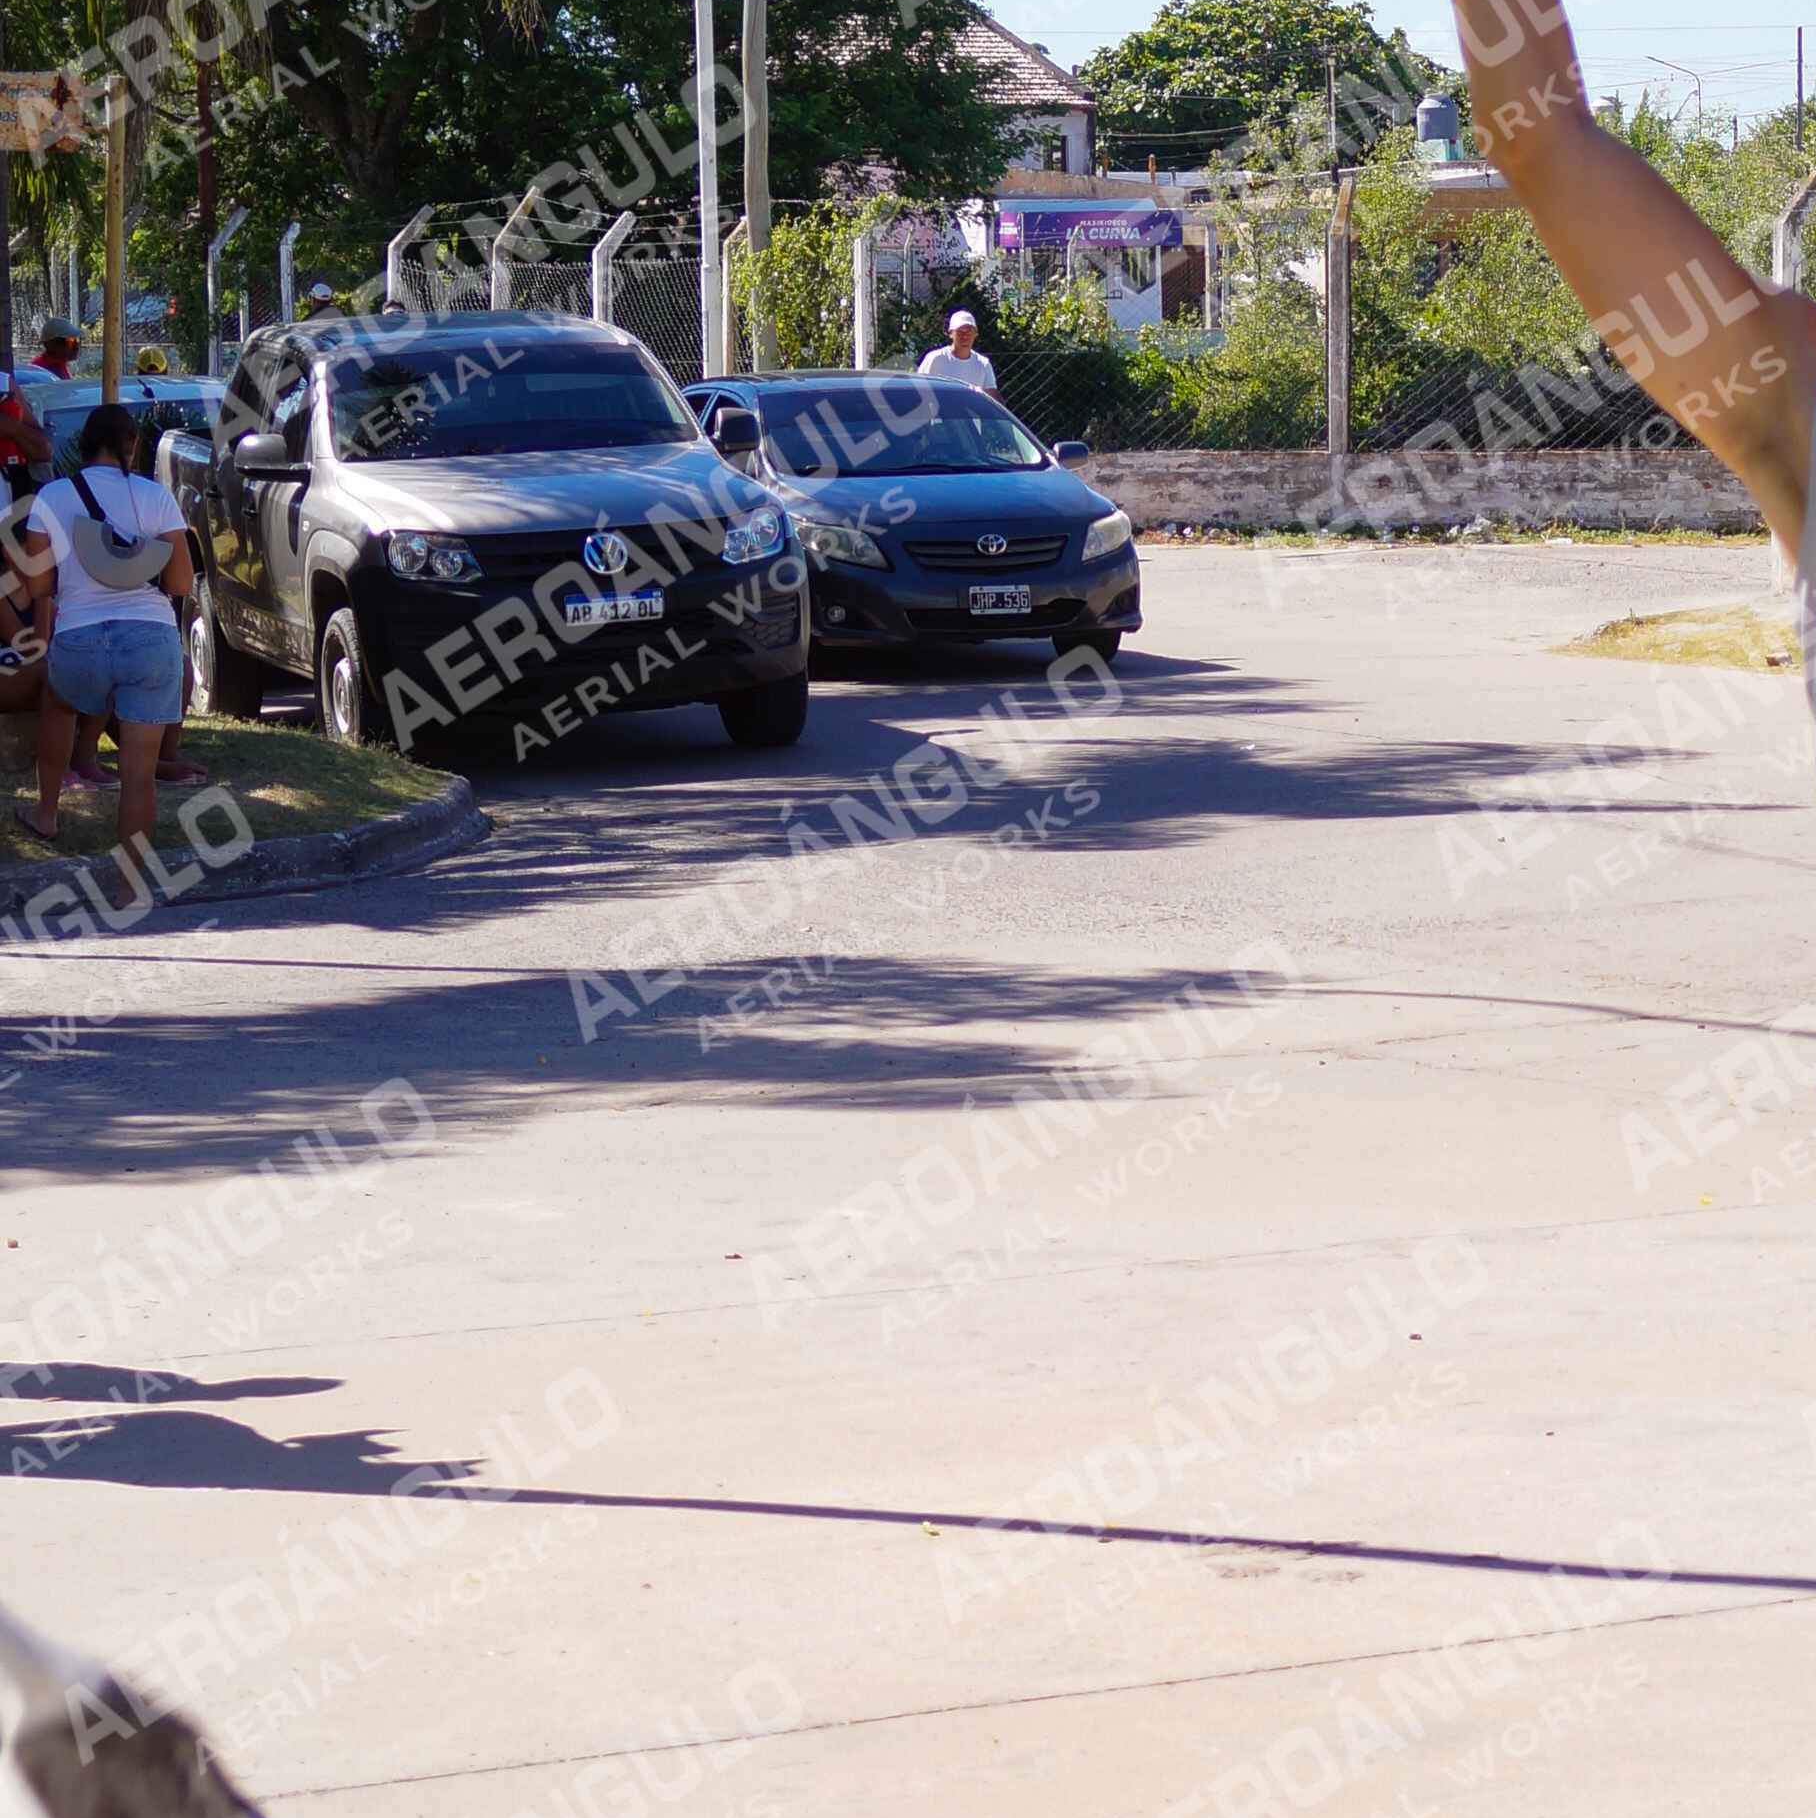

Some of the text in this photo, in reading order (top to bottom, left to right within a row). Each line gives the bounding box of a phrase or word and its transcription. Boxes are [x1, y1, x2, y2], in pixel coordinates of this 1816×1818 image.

[1065, 227, 1141, 241] LA CURVA
[571, 605, 592, 623] AB
[600, 602, 631, 620] 412
